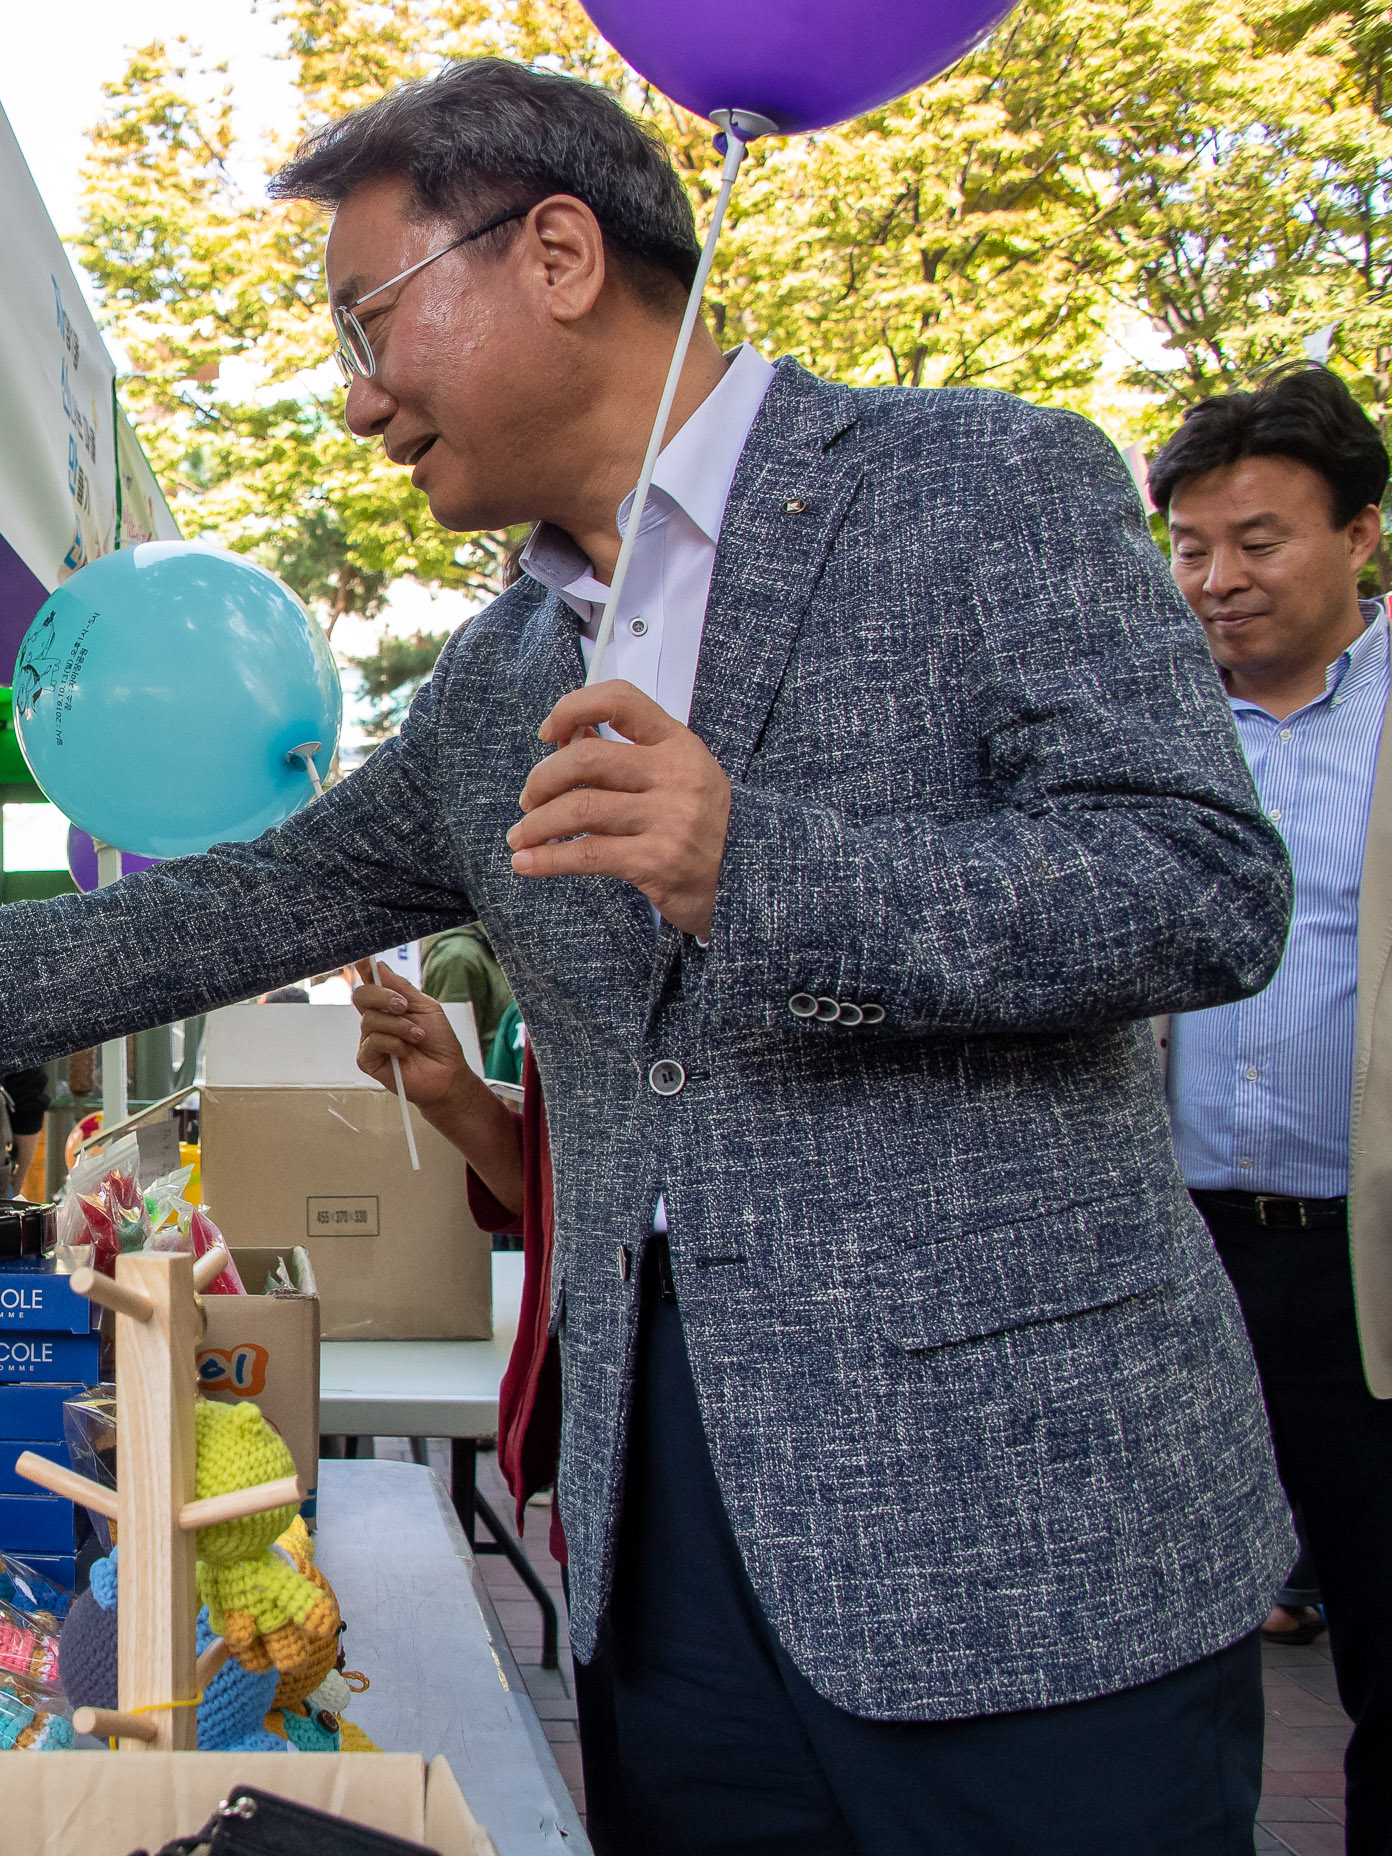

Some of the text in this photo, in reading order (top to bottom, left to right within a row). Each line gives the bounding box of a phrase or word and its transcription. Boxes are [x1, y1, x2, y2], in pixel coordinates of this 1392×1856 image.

[70, 611, 101, 657] 오후1시-5시
[55, 658, 74, 723] 2019.10.13(일)
[63, 694, 73, 712] 장소
[55, 729, 64, 746] 일시
